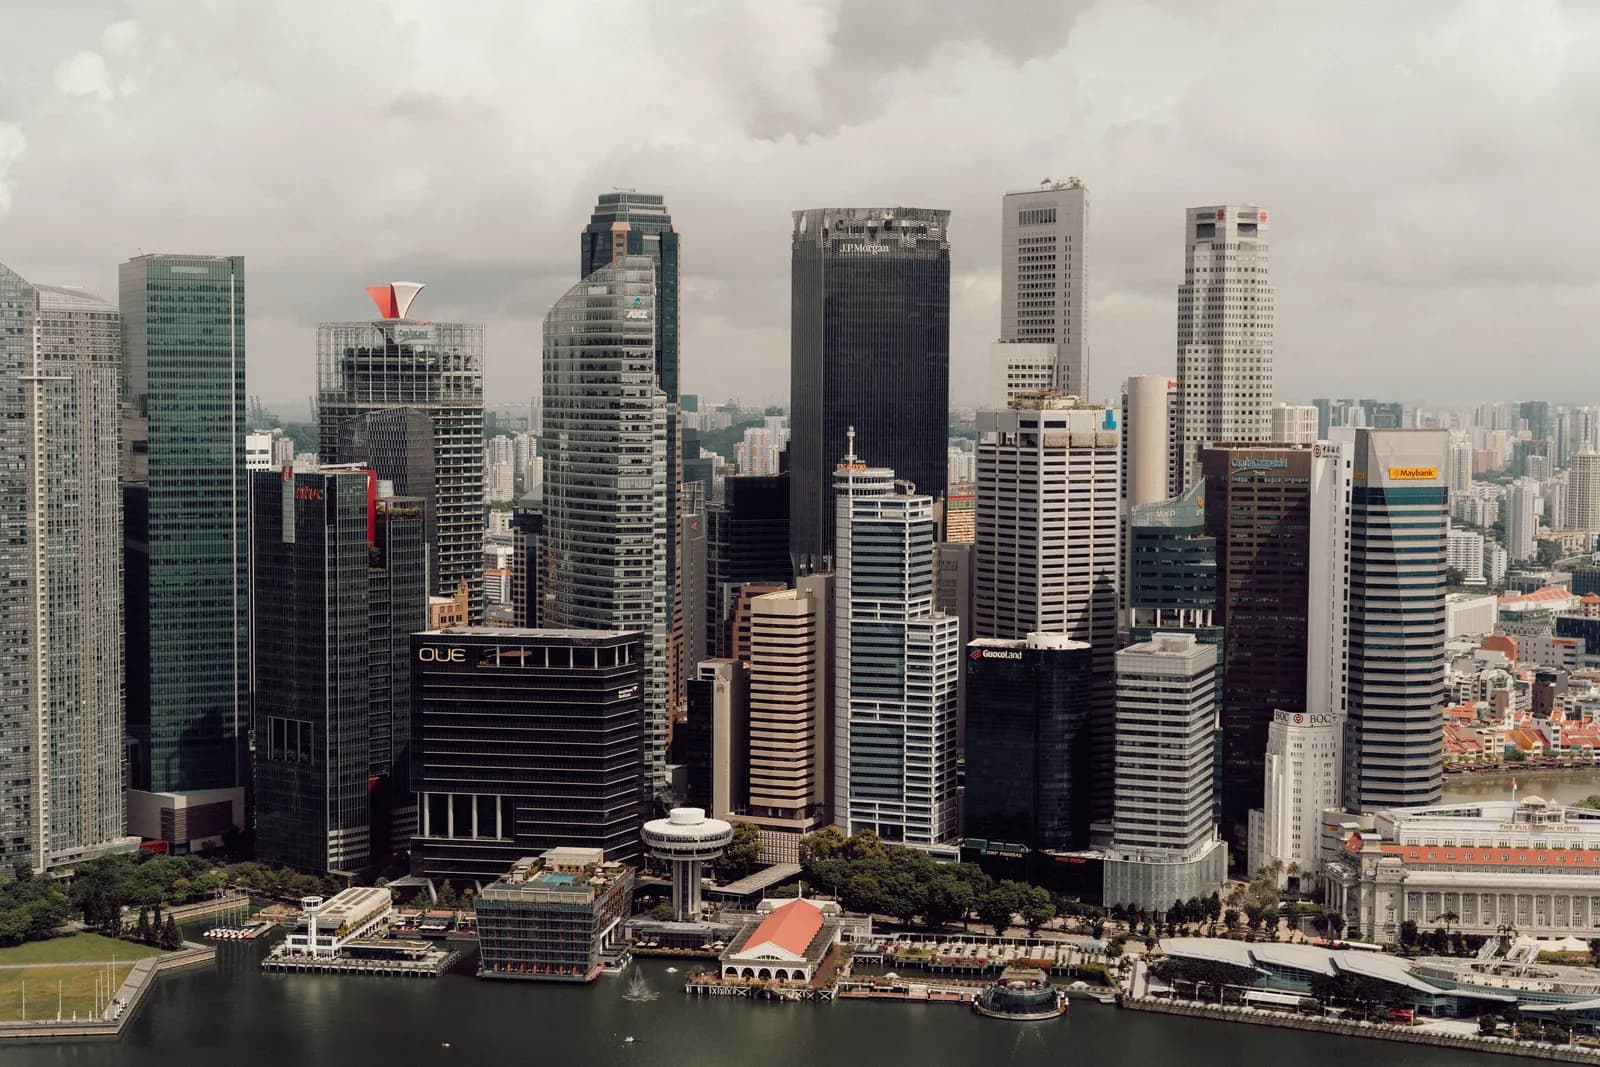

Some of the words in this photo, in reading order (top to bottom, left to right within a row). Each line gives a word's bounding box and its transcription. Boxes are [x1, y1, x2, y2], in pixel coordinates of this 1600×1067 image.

[1400, 469, 1433, 477] Maybank
[418, 647, 467, 662] OUE
[982, 649, 1023, 660] GuocoLand
[1275, 710, 1290, 722] BOC
[1309, 713, 1332, 723] BOC
